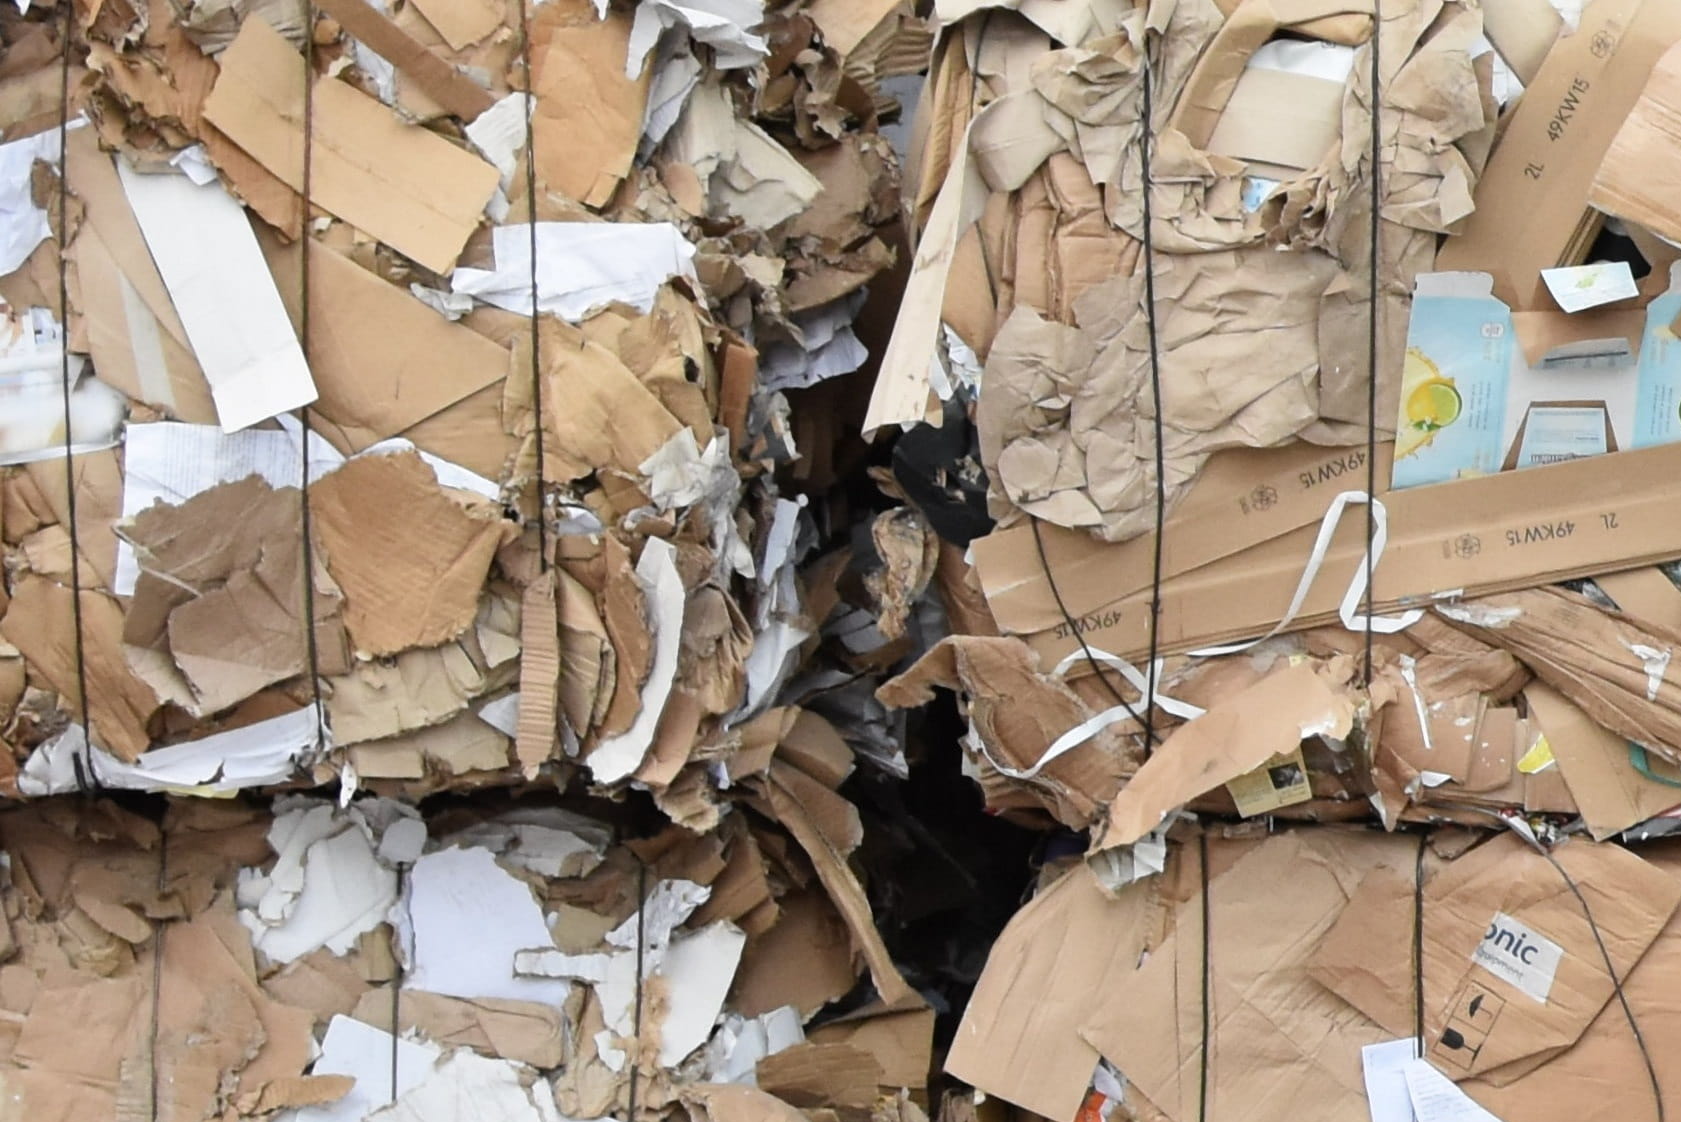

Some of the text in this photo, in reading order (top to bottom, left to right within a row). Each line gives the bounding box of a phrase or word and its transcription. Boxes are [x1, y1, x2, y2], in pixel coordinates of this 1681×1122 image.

[1523, 77, 1590, 181] 2L 49KW15
[1299, 452, 1366, 488] 49KW15
[1505, 513, 1618, 546] 2L 49KW15
